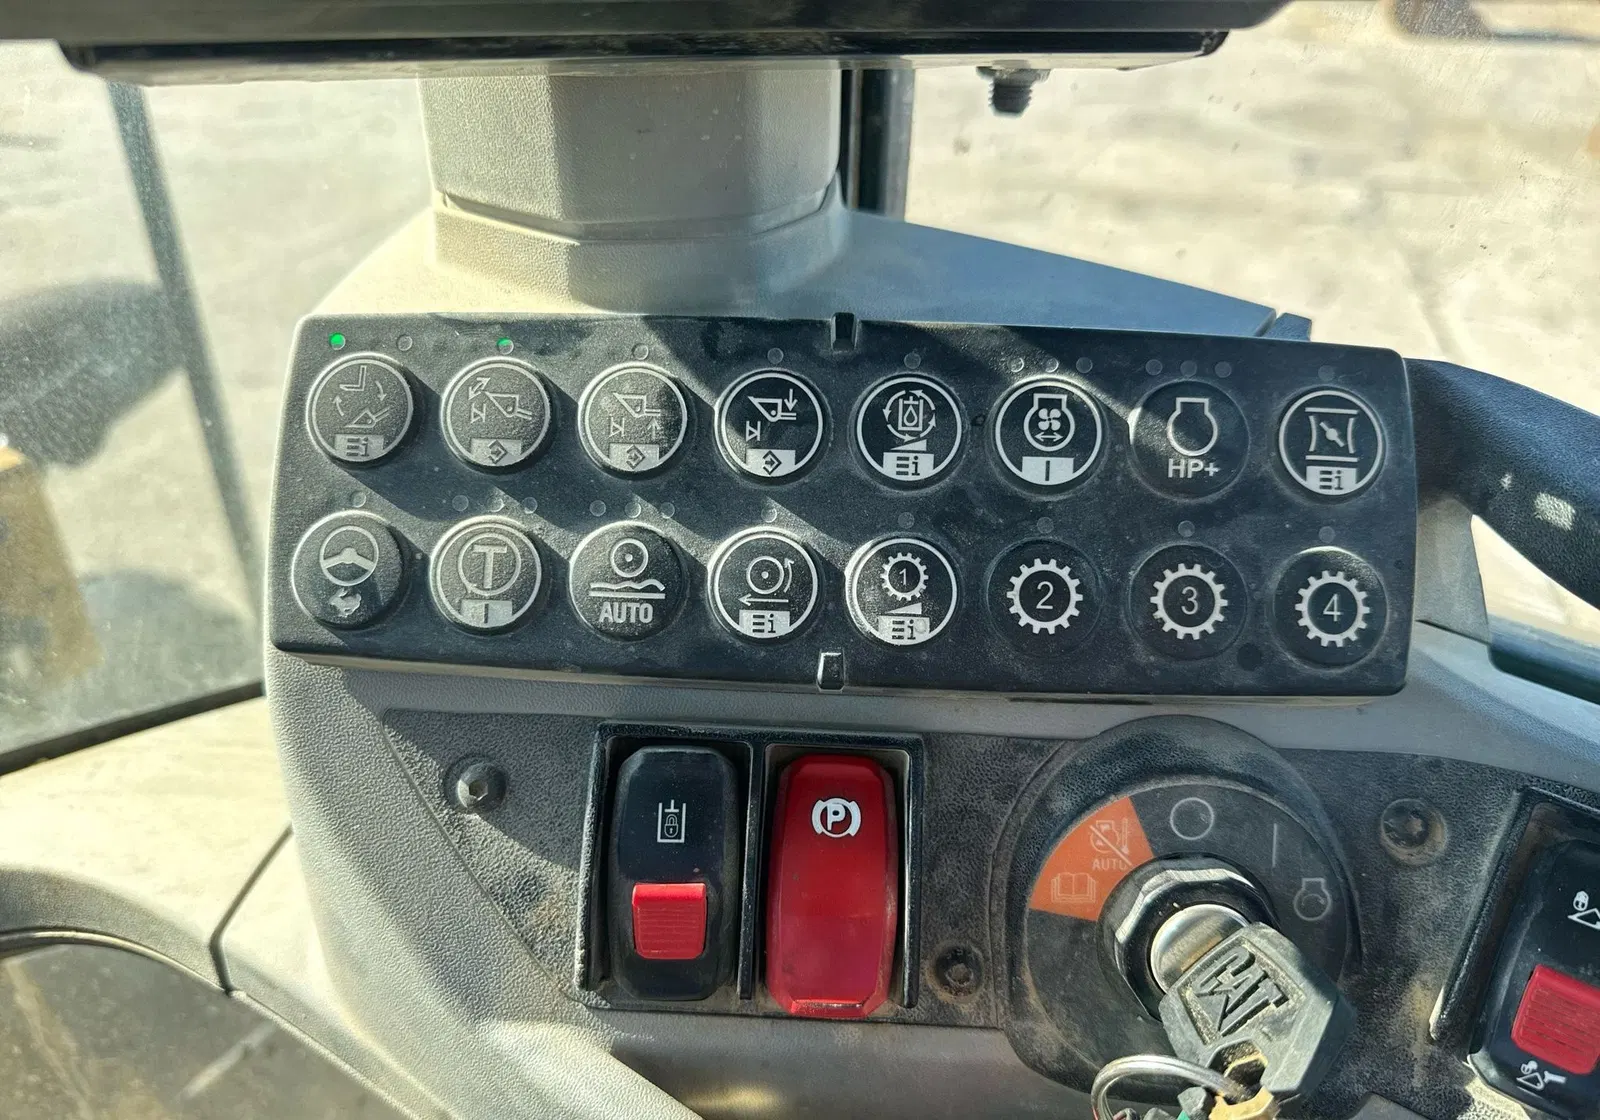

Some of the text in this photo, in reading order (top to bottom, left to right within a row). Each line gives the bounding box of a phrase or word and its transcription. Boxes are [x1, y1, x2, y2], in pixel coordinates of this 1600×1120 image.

[1168, 458, 1220, 479] HP+
[899, 568, 907, 587] 1
[1036, 581, 1054, 610] 2
[1181, 586, 1199, 615] 3
[1323, 593, 1344, 622] 4
[599, 601, 654, 624] AUTO
[827, 803, 846, 831] P
[1194, 945, 1290, 1037] CAT
